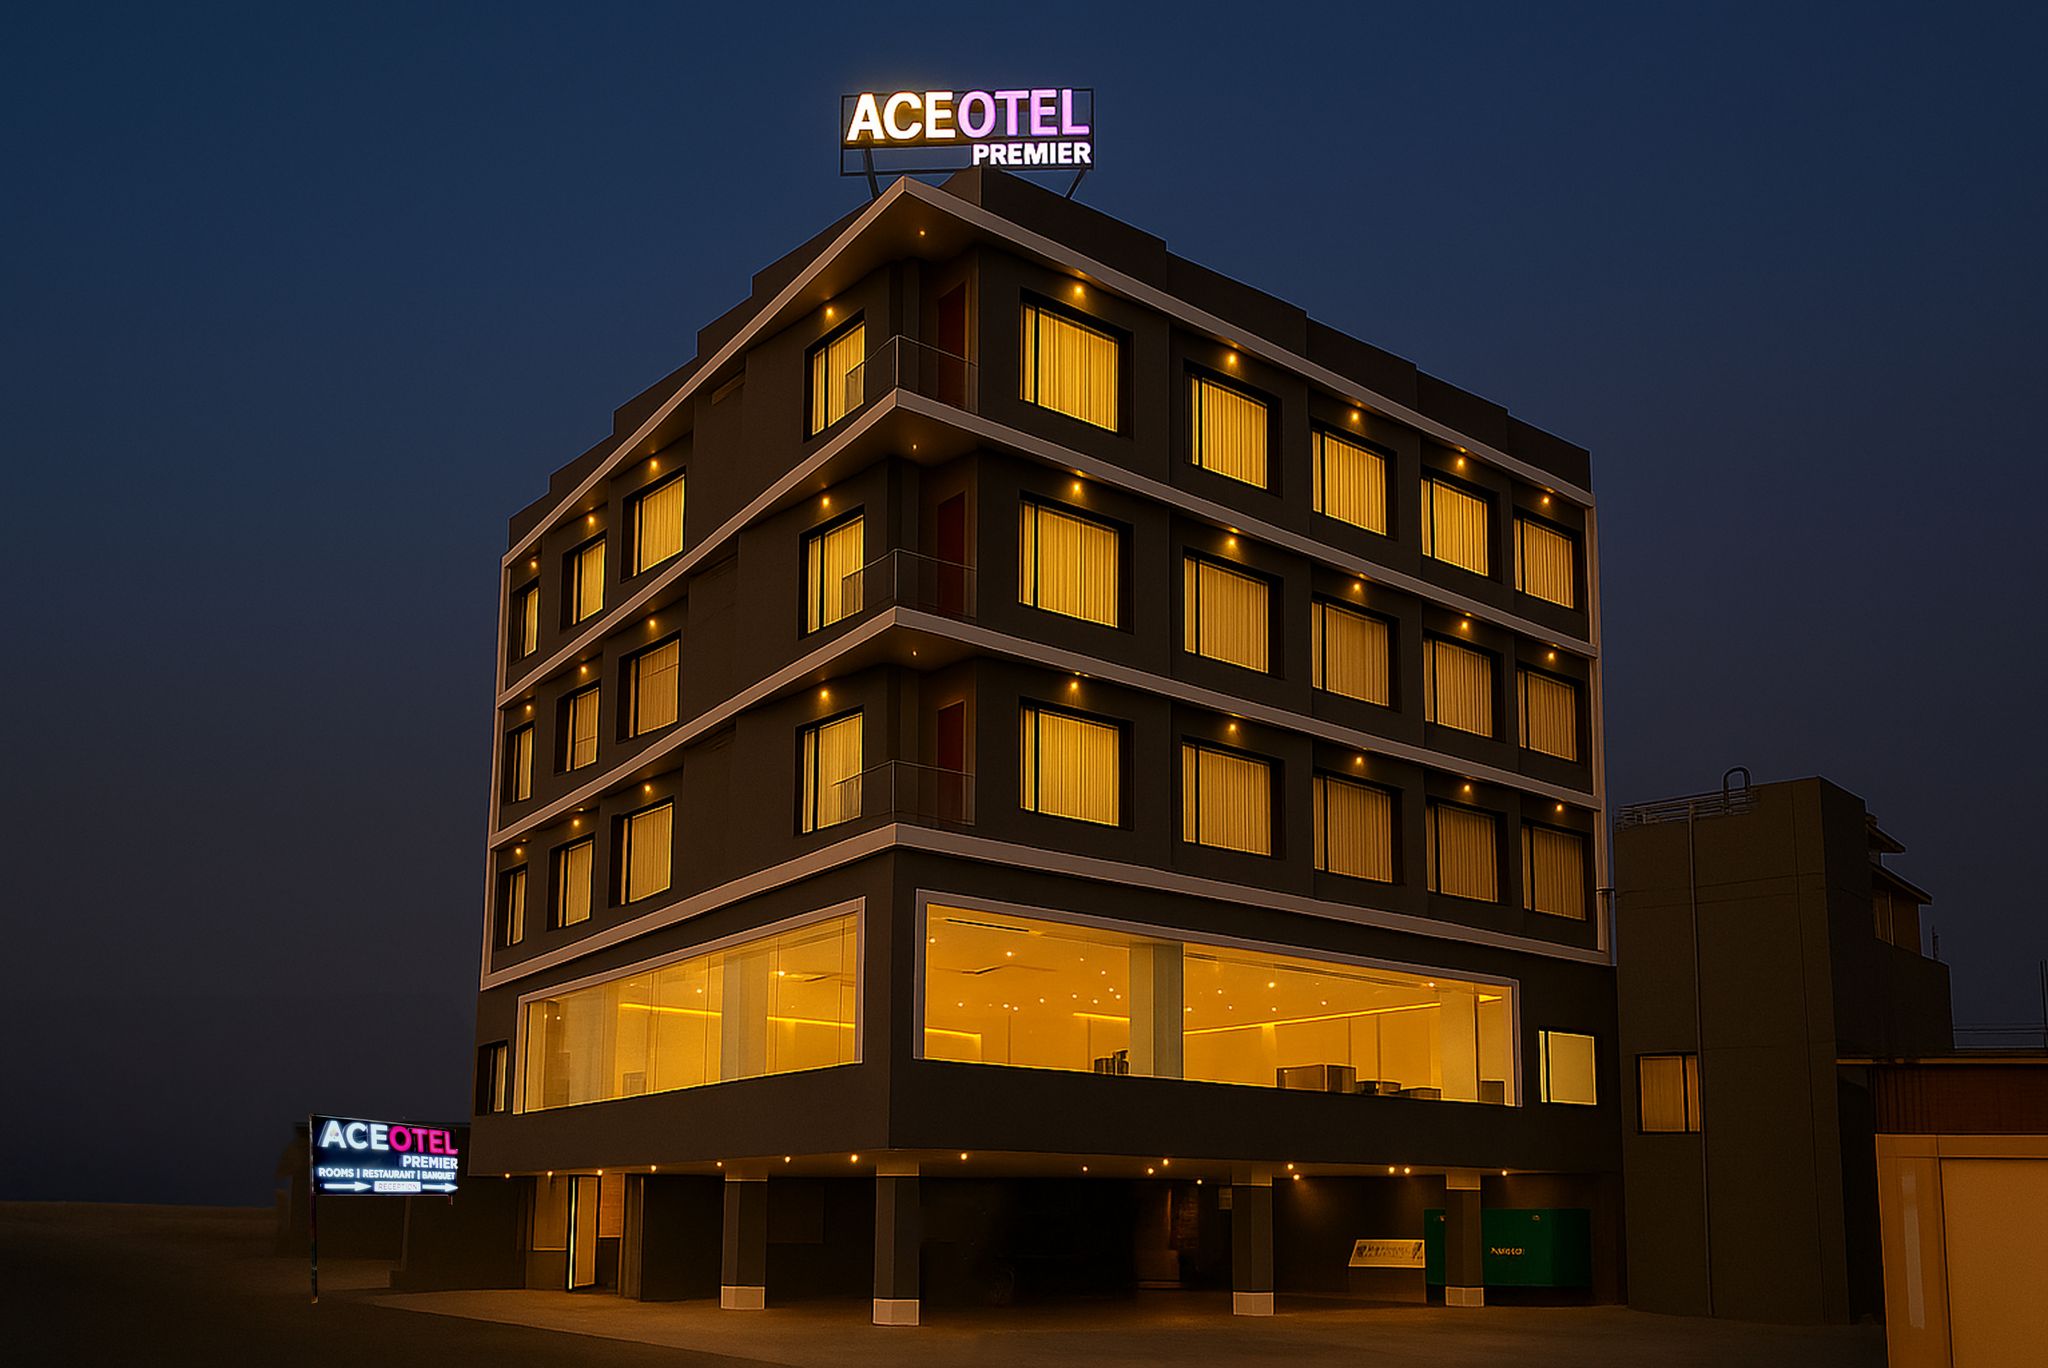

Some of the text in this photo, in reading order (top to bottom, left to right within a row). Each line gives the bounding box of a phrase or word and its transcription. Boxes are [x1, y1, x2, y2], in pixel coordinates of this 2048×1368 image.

[972, 142, 1092, 166] PREMIER
[402, 1155, 459, 1170] PREMIER
[318, 1167, 456, 1180] ROOMS RESTAURANT BANQUET
[378, 1182, 418, 1191] RECEPTION
